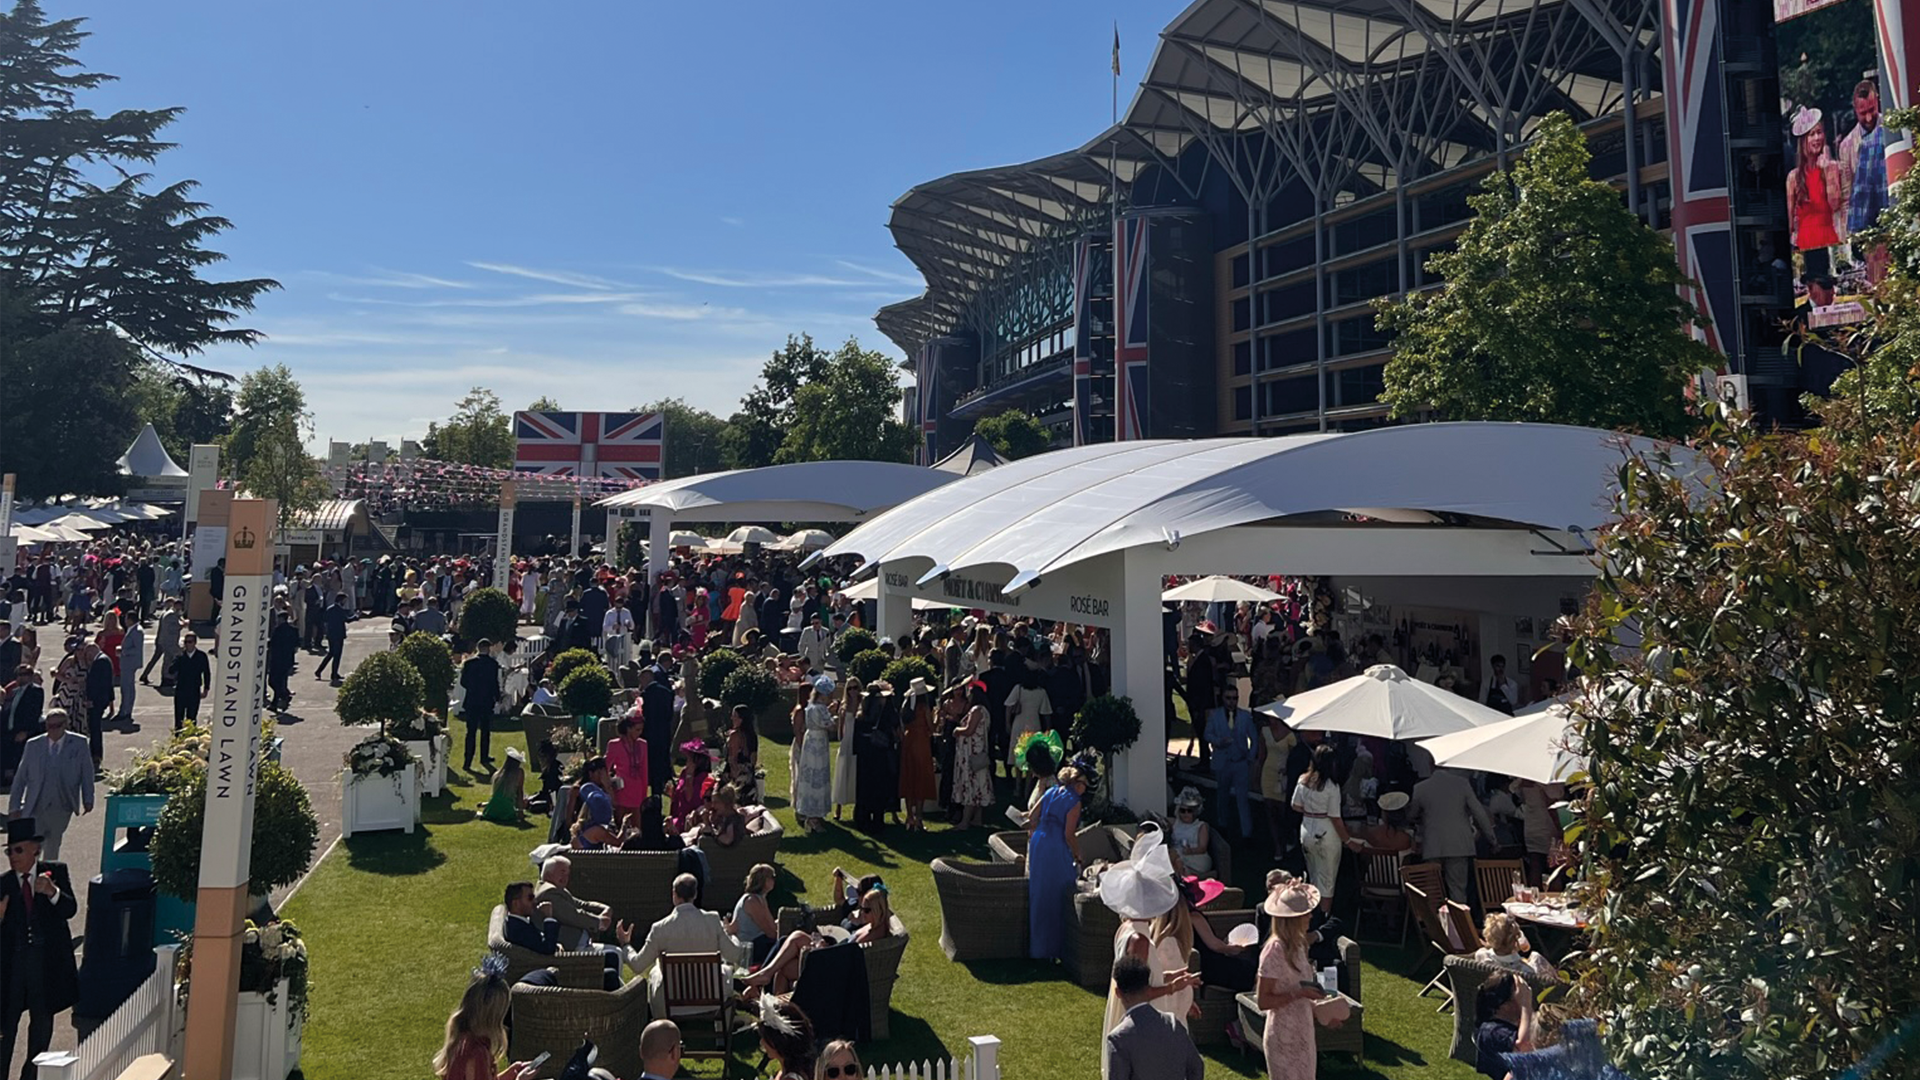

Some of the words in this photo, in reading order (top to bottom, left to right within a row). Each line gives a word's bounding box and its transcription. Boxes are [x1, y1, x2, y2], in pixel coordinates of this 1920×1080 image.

[500, 512, 509, 563] GRANDSTAND
[498, 565, 507, 588] LAWN
[967, 579, 975, 600] &
[1071, 594, 1091, 614] ROSÉ
[1092, 598, 1109, 616] BAR
[223, 585, 247, 727] GRANDSTAND
[252, 585, 269, 725] GRANDSTAND
[216, 738, 235, 798] LAWN
[246, 736, 257, 796] LAWN
